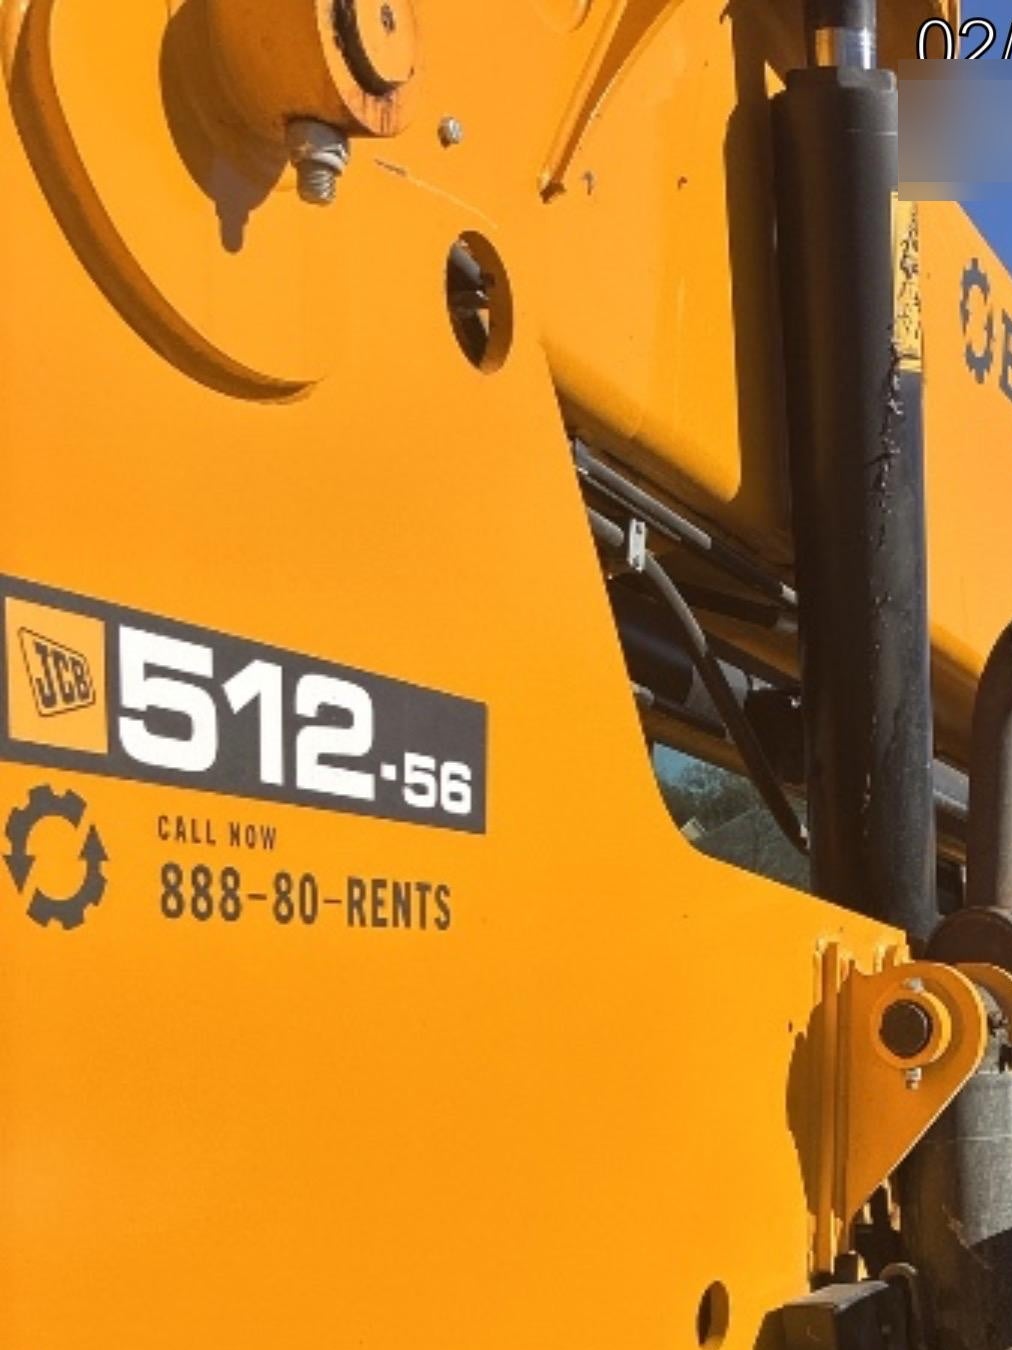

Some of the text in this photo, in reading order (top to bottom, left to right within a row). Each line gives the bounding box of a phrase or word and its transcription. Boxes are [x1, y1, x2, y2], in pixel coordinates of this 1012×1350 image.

[32, 640, 93, 711] JCB
[157, 815, 278, 851] CALL NOW
[159, 861, 452, 932] 888-80-RENTS
